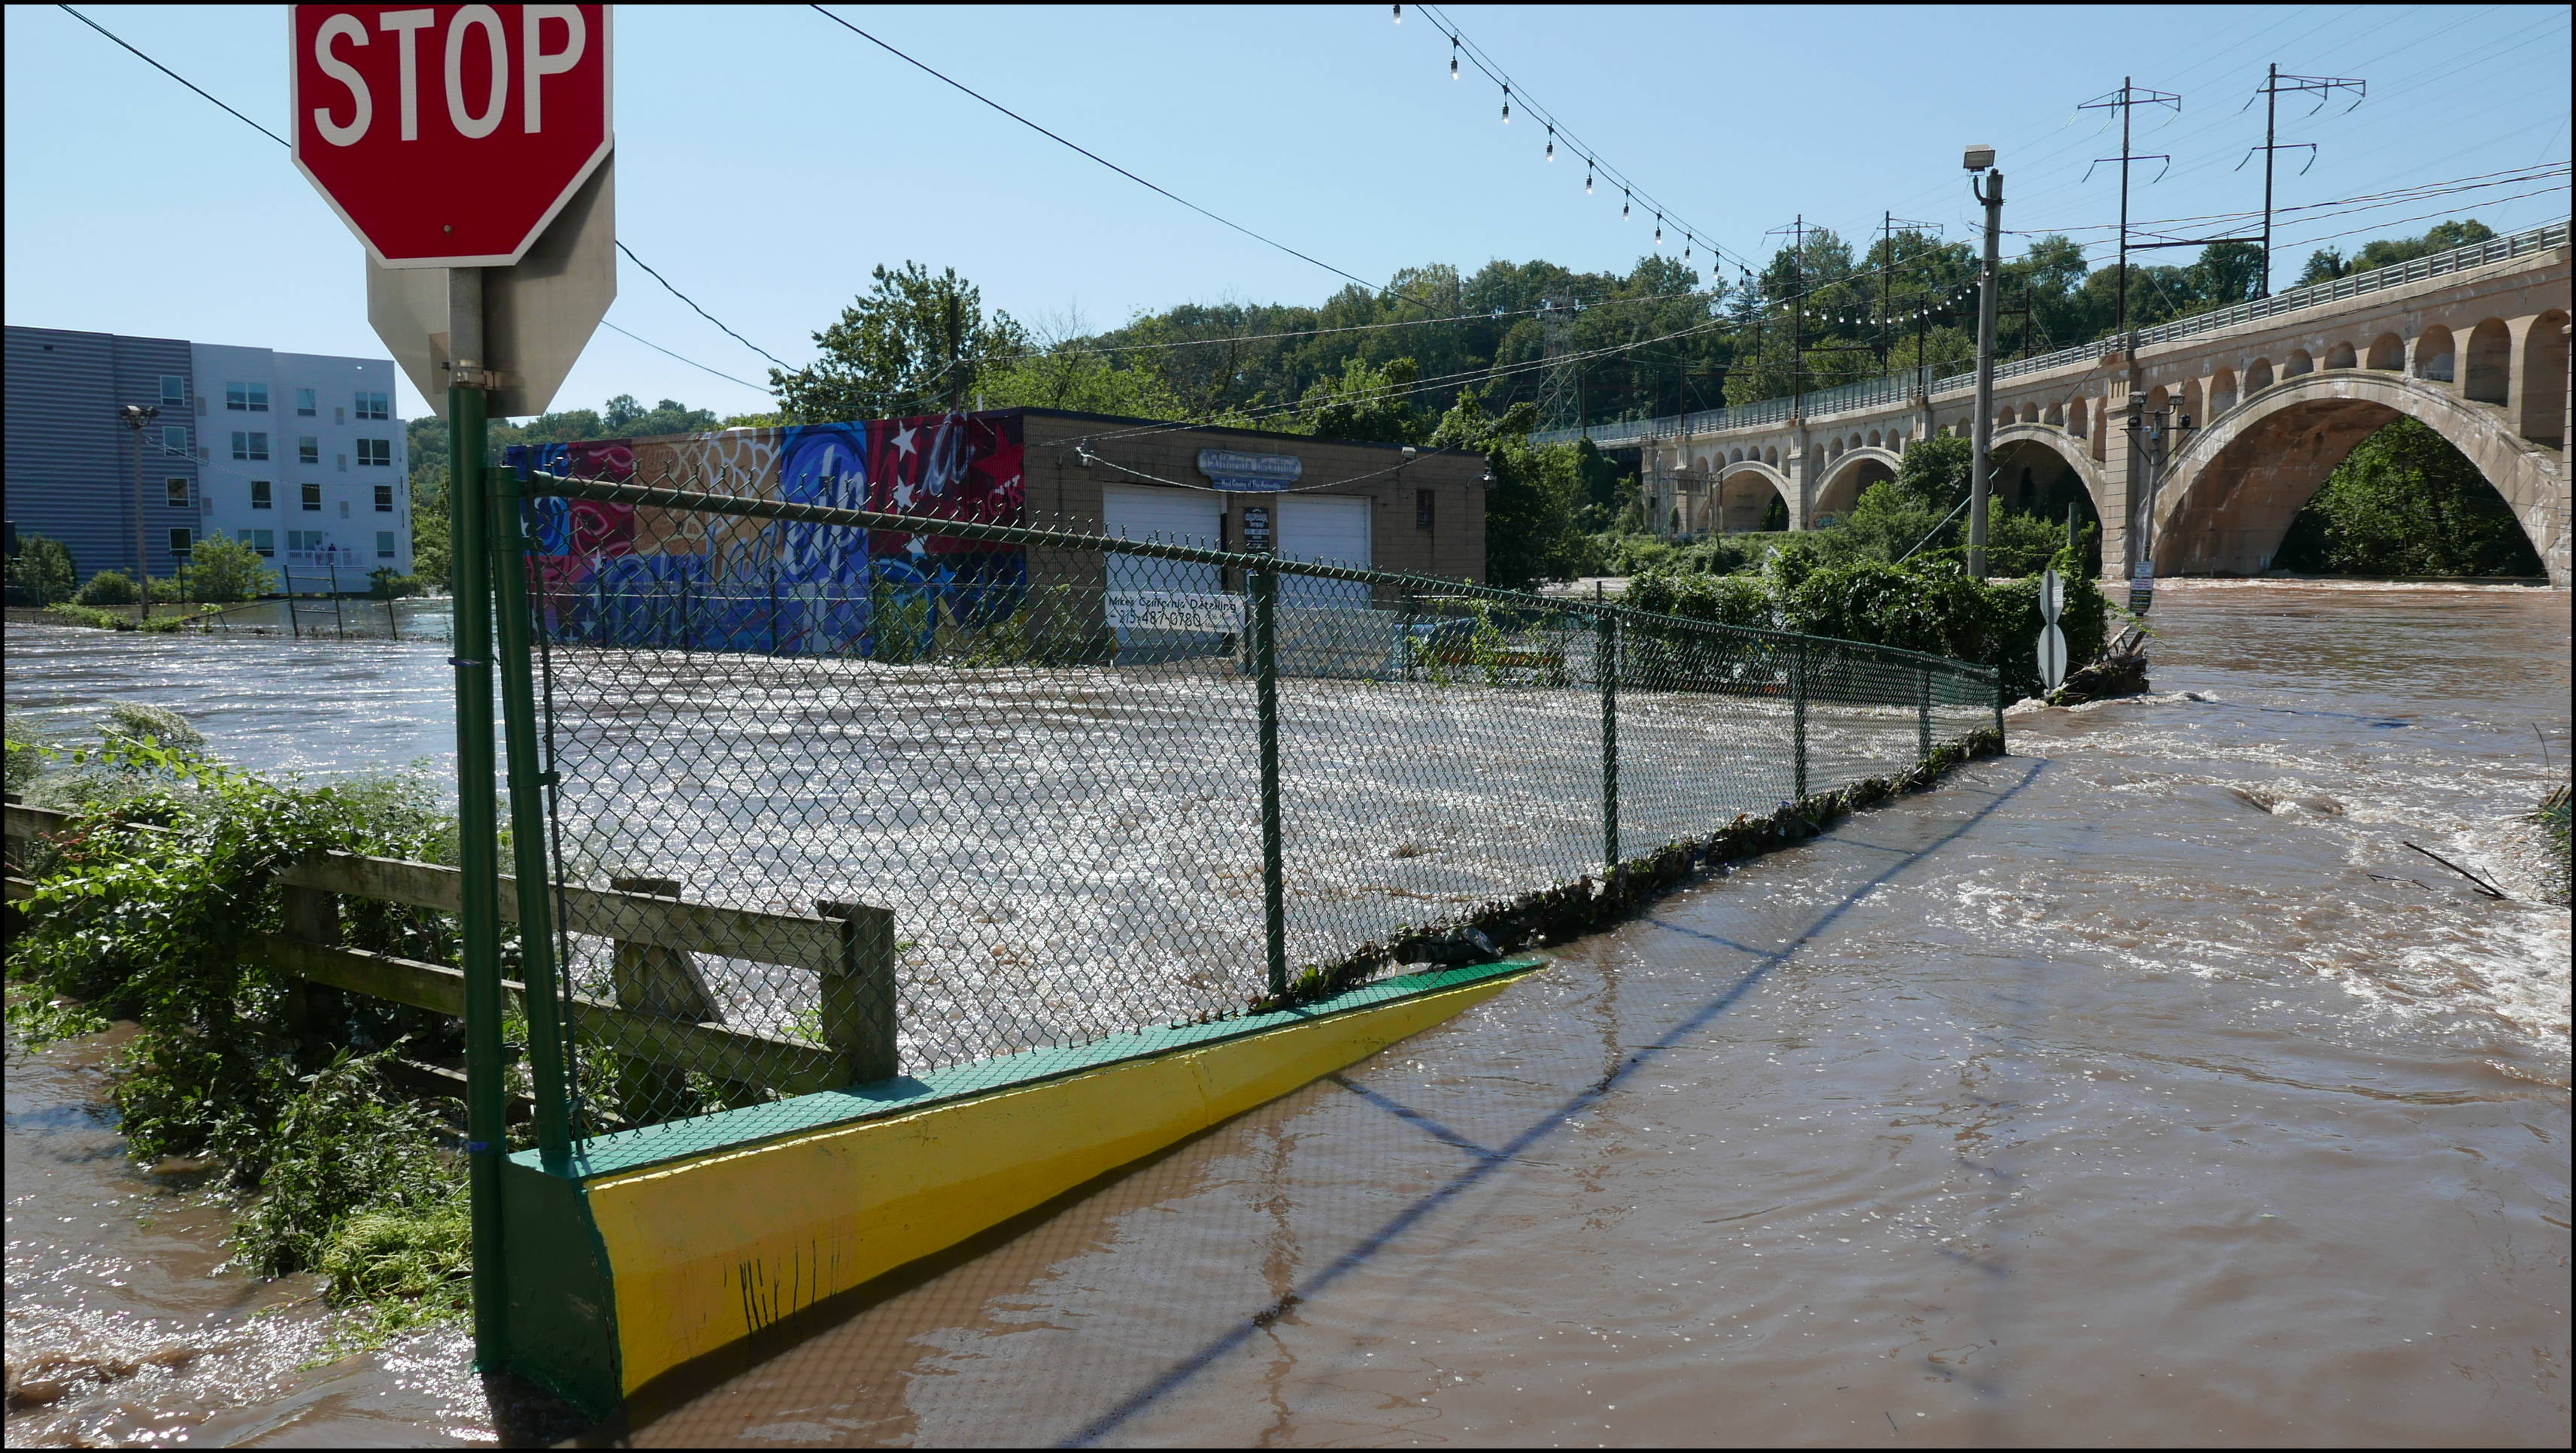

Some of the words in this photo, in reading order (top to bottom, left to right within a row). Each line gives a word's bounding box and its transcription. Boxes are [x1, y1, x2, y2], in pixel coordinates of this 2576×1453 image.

[314, 5, 587, 147] STOP
[1201, 451, 1252, 471] California
[1139, 597, 1185, 608] California
[1190, 599, 1236, 614] Detailing
